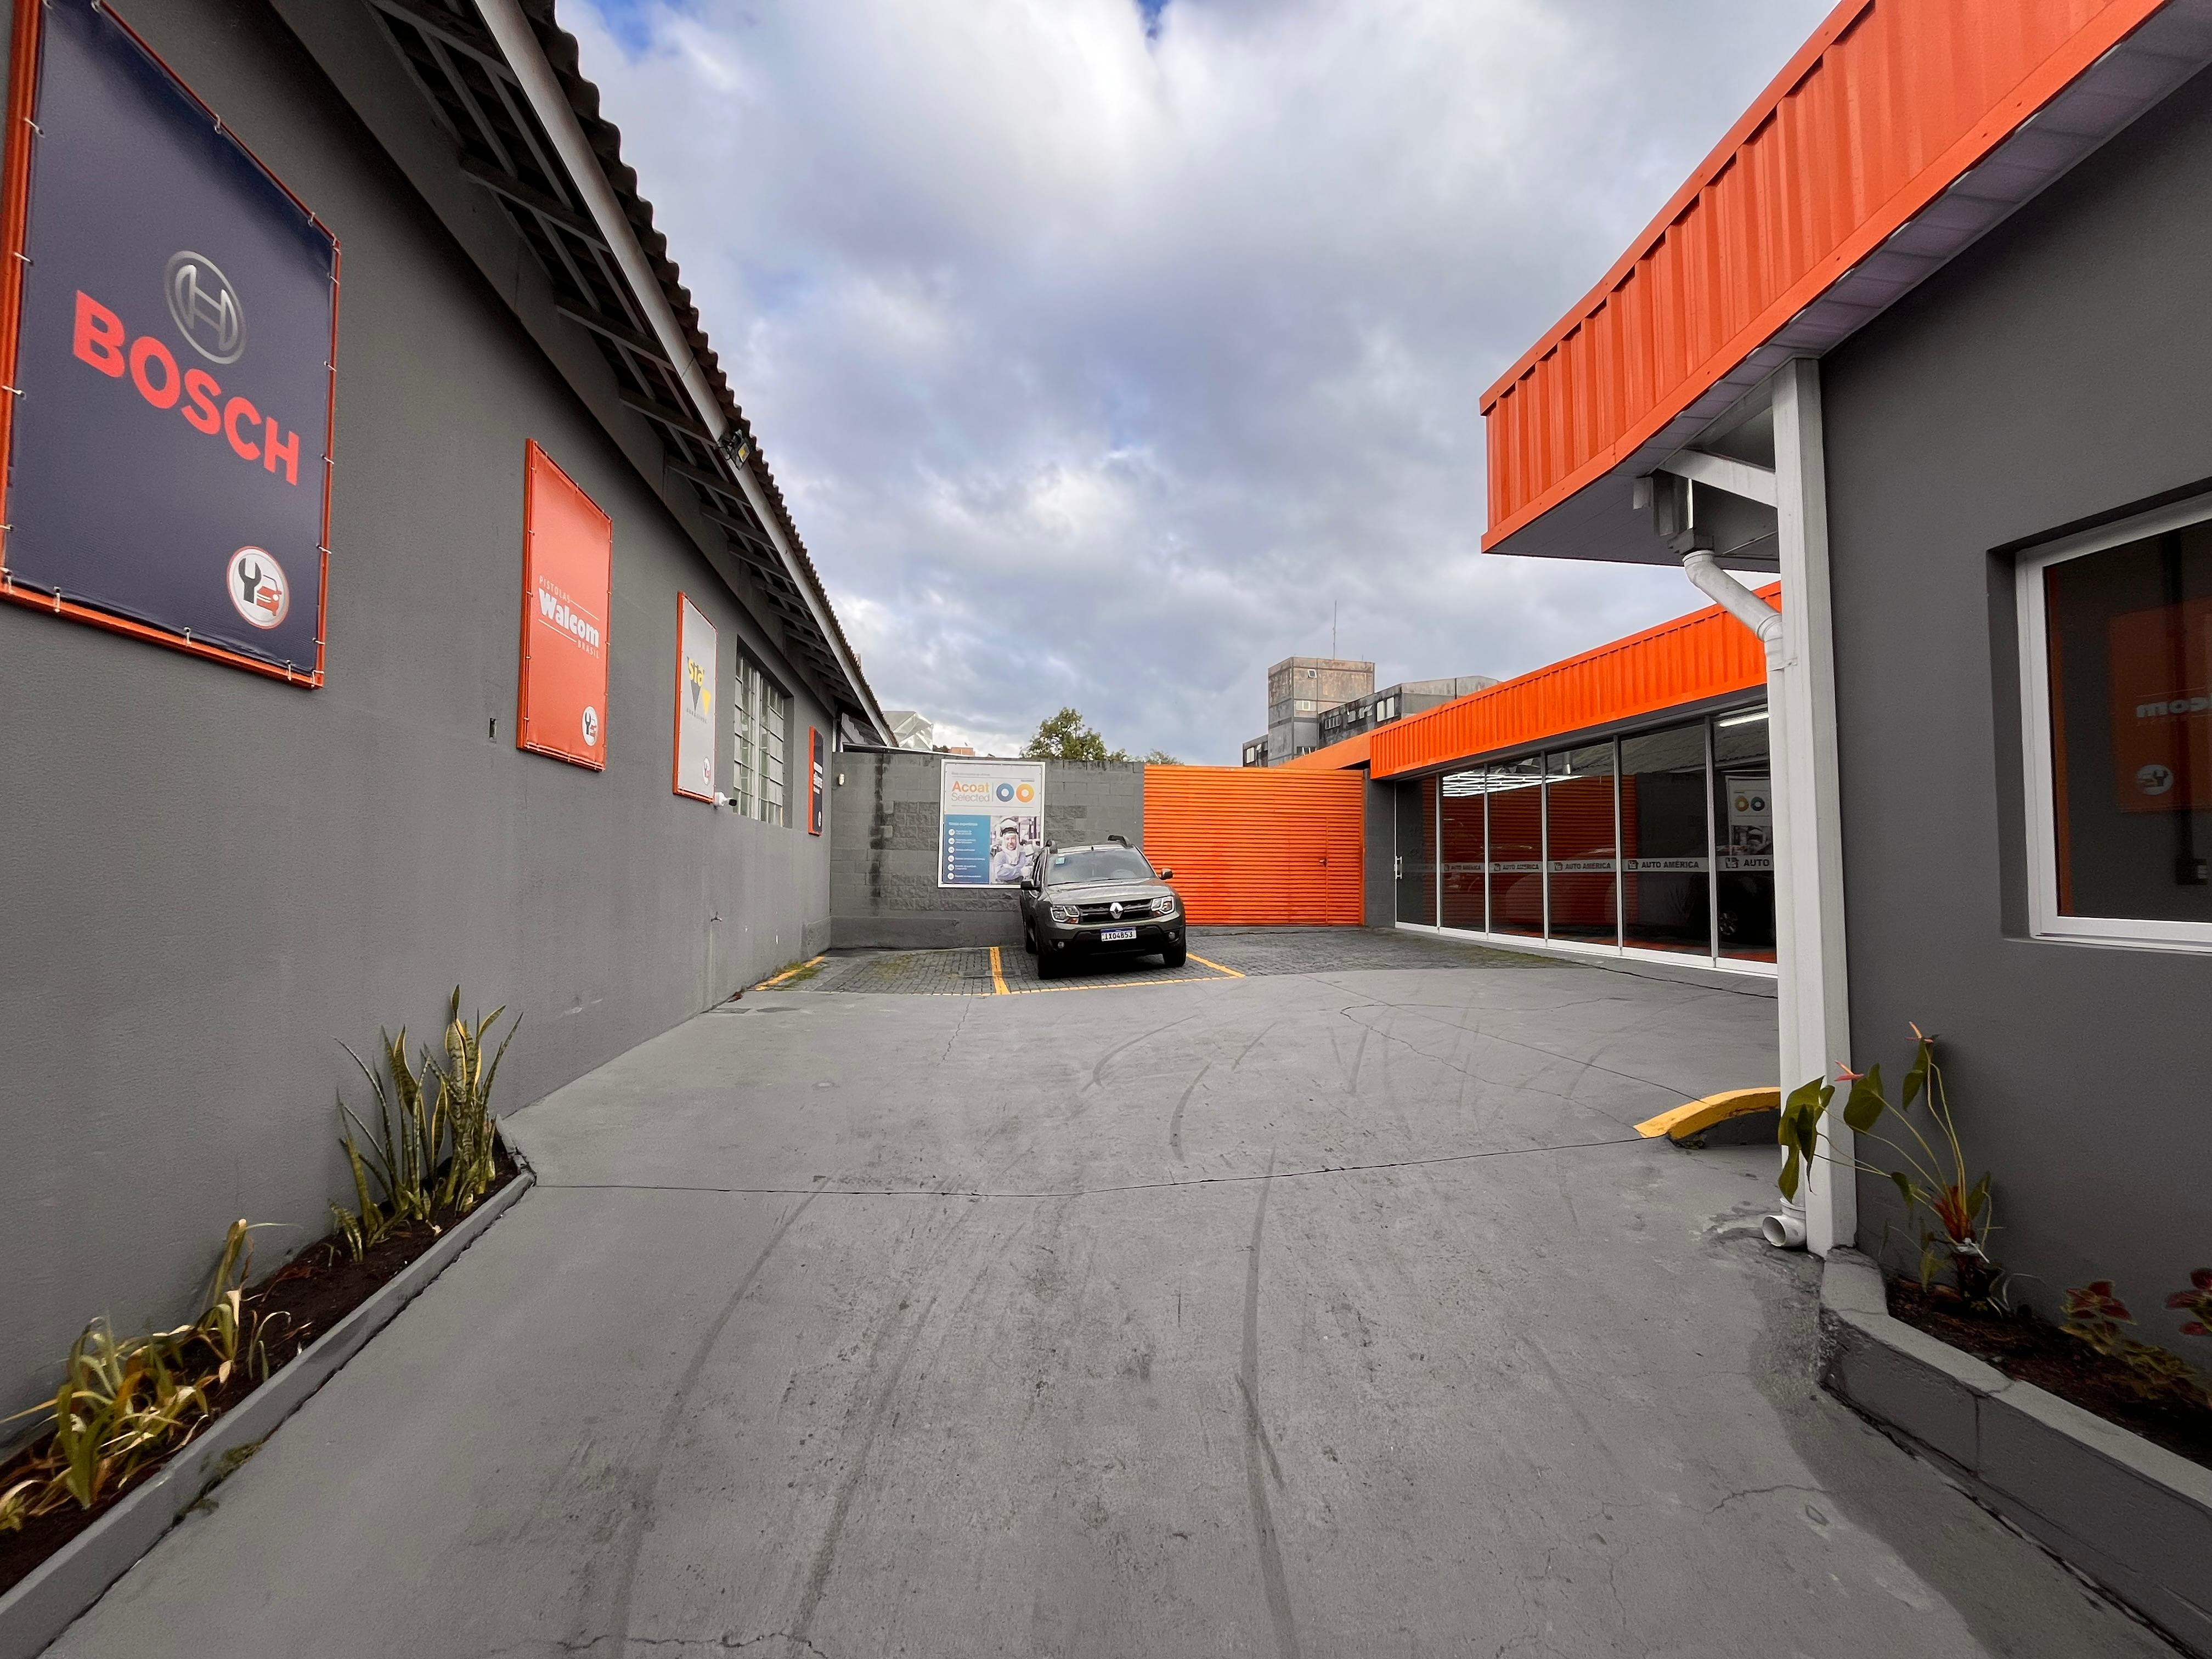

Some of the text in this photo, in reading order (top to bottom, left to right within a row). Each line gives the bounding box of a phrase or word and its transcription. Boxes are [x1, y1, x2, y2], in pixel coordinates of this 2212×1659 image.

[74, 290, 300, 486] BOSCH
[539, 575, 571, 603] PISTOLAS
[538, 588, 599, 648] Walcom
[578, 639, 600, 659] BRASIL
[951, 792, 990, 802] Selected
[952, 781, 990, 793] Acoat
[1743, 859, 1770, 867] AUTO
